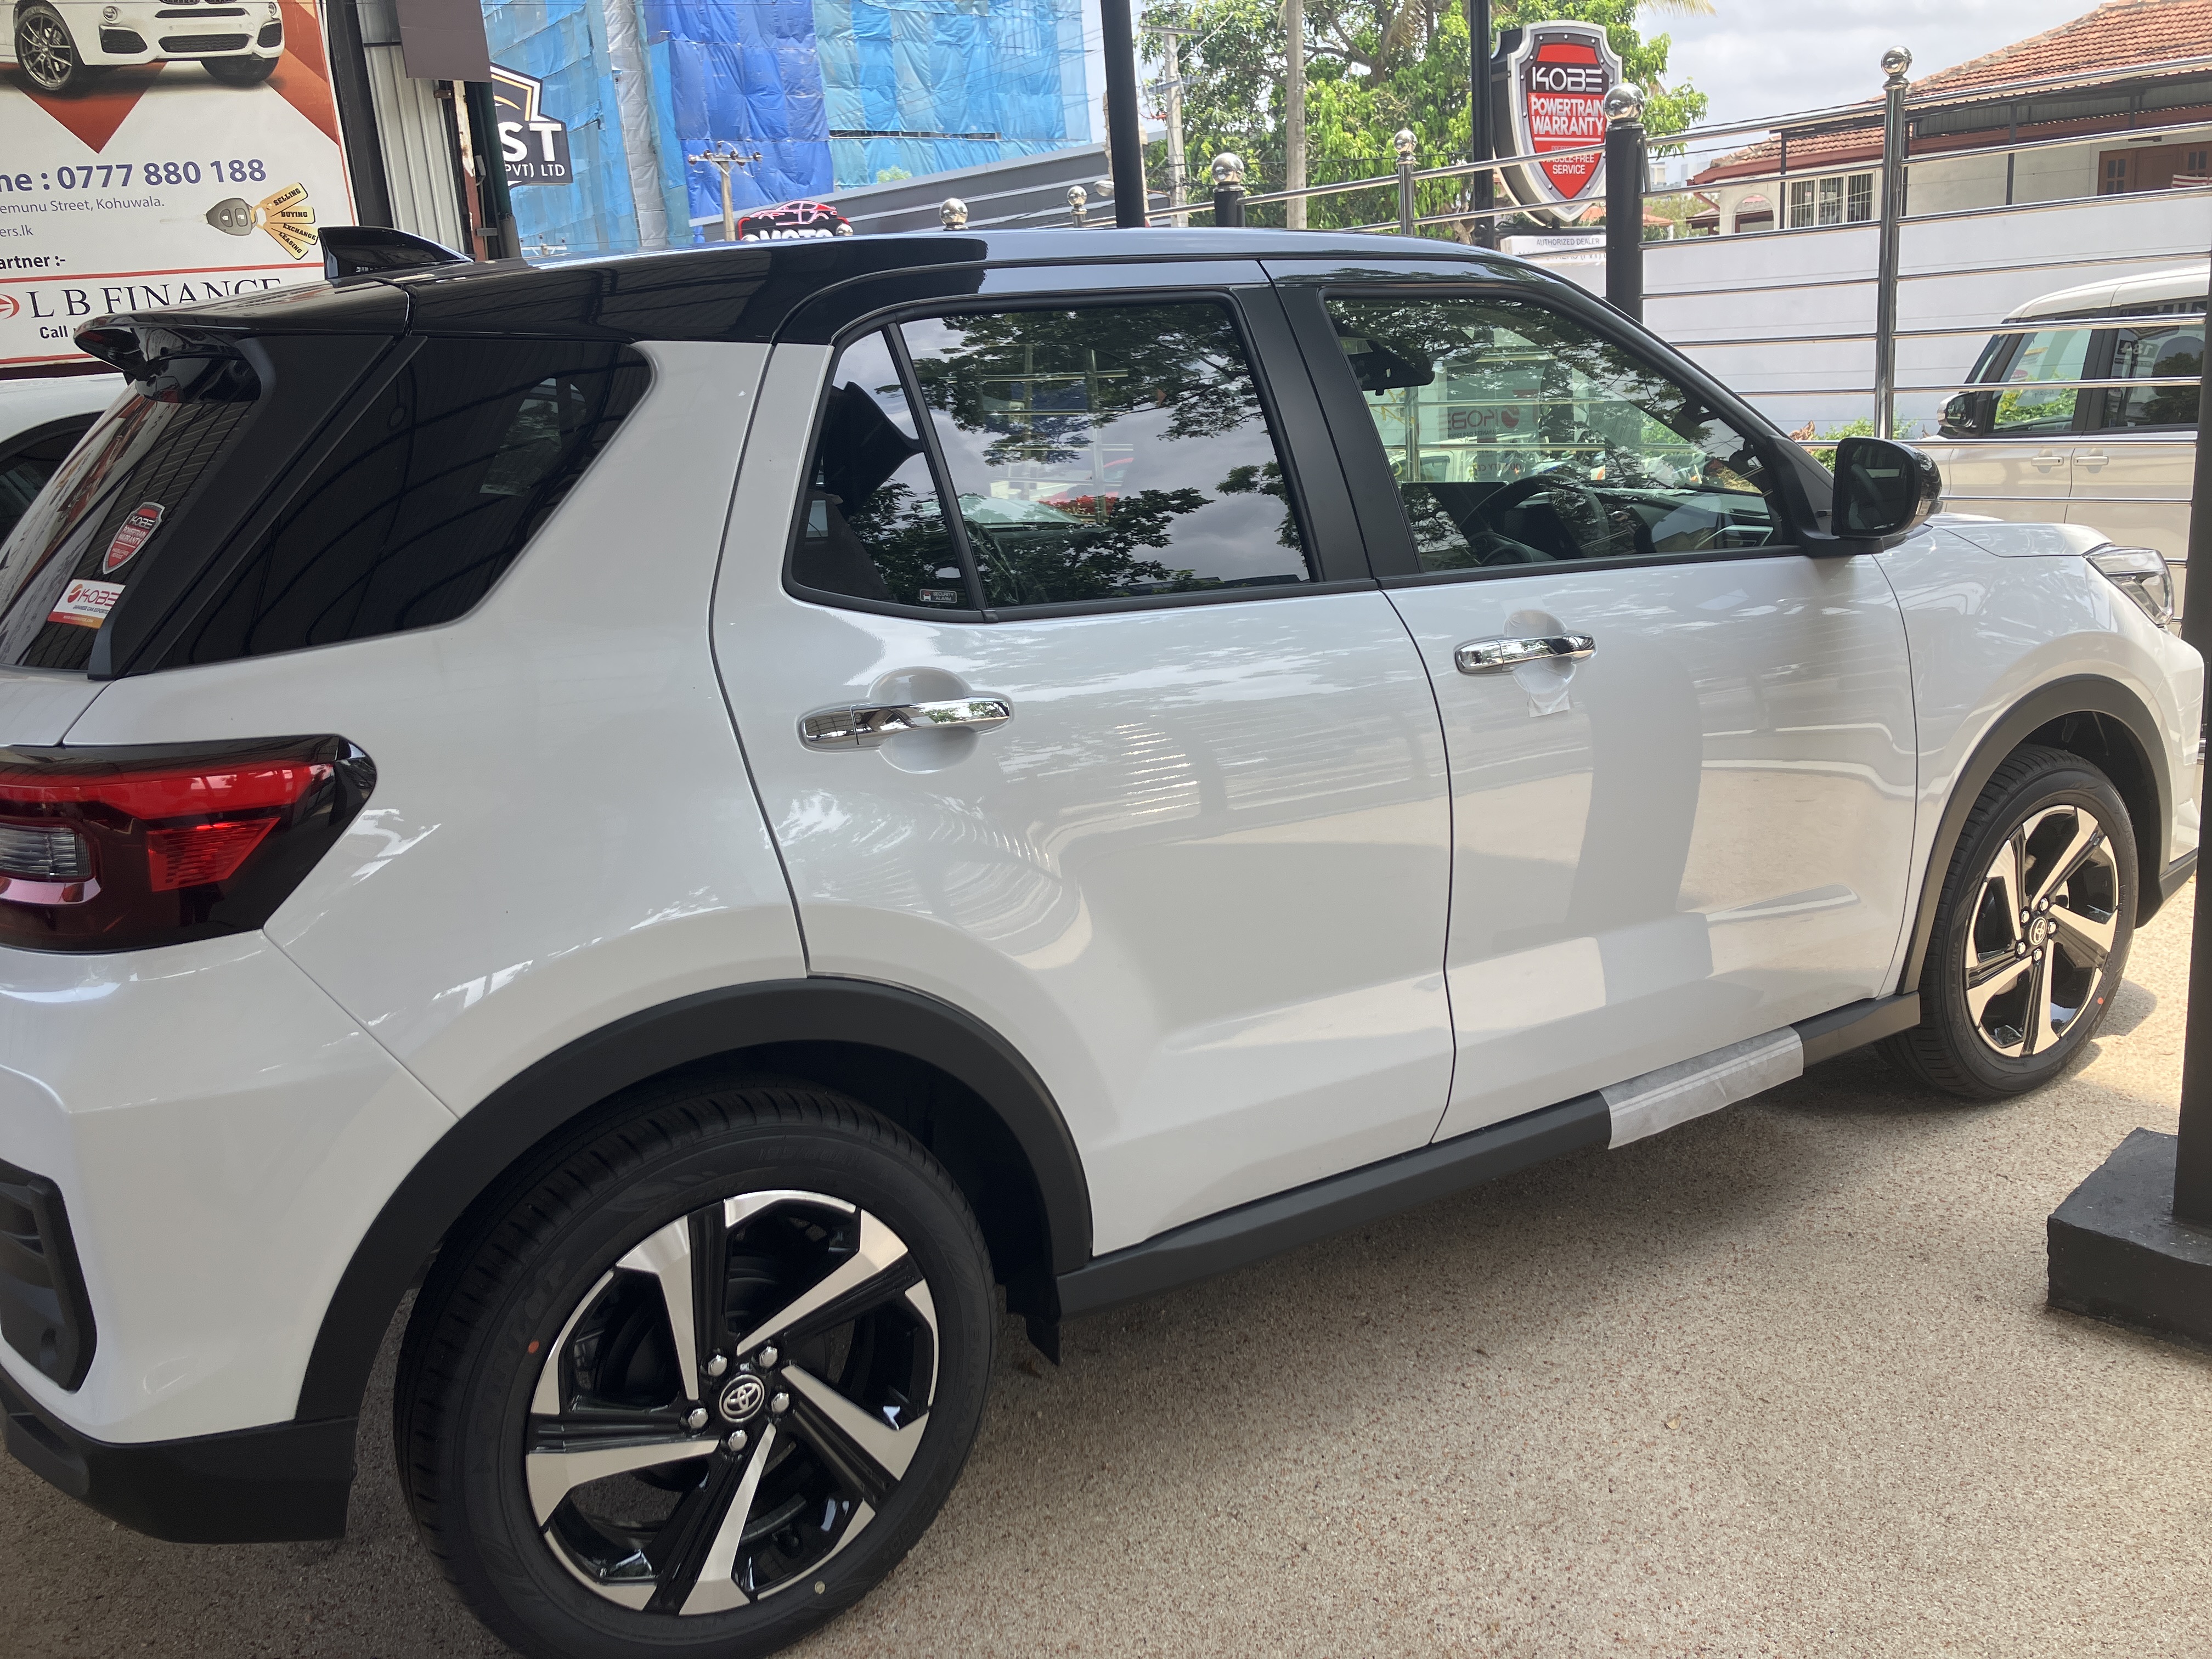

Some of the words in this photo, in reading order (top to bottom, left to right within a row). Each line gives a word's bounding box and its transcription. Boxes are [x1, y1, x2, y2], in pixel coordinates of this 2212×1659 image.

[1532, 66, 1602, 92] KOBE
[1531, 95, 1605, 116] POWERTRAIN
[1532, 116, 1604, 136] WARRANTY
[57, 164, 133, 189] 0777
[144, 161, 201, 185] 880
[210, 159, 266, 183] 188
[541, 164, 565, 177] LTD
[1552, 165, 1585, 174] SERVICE
[50, 200, 93, 211] Street,
[97, 196, 165, 210] Kohuwala.
[273, 188, 301, 206] SELLING
[283, 223, 316, 240] EXCHANGE
[278, 232, 302, 253] LEASING
[25, 291, 54, 318] L
[60, 290, 91, 316] B
[40, 325, 67, 338] Call
[129, 516, 155, 529] KOBE
[77, 588, 120, 607] KOBE
